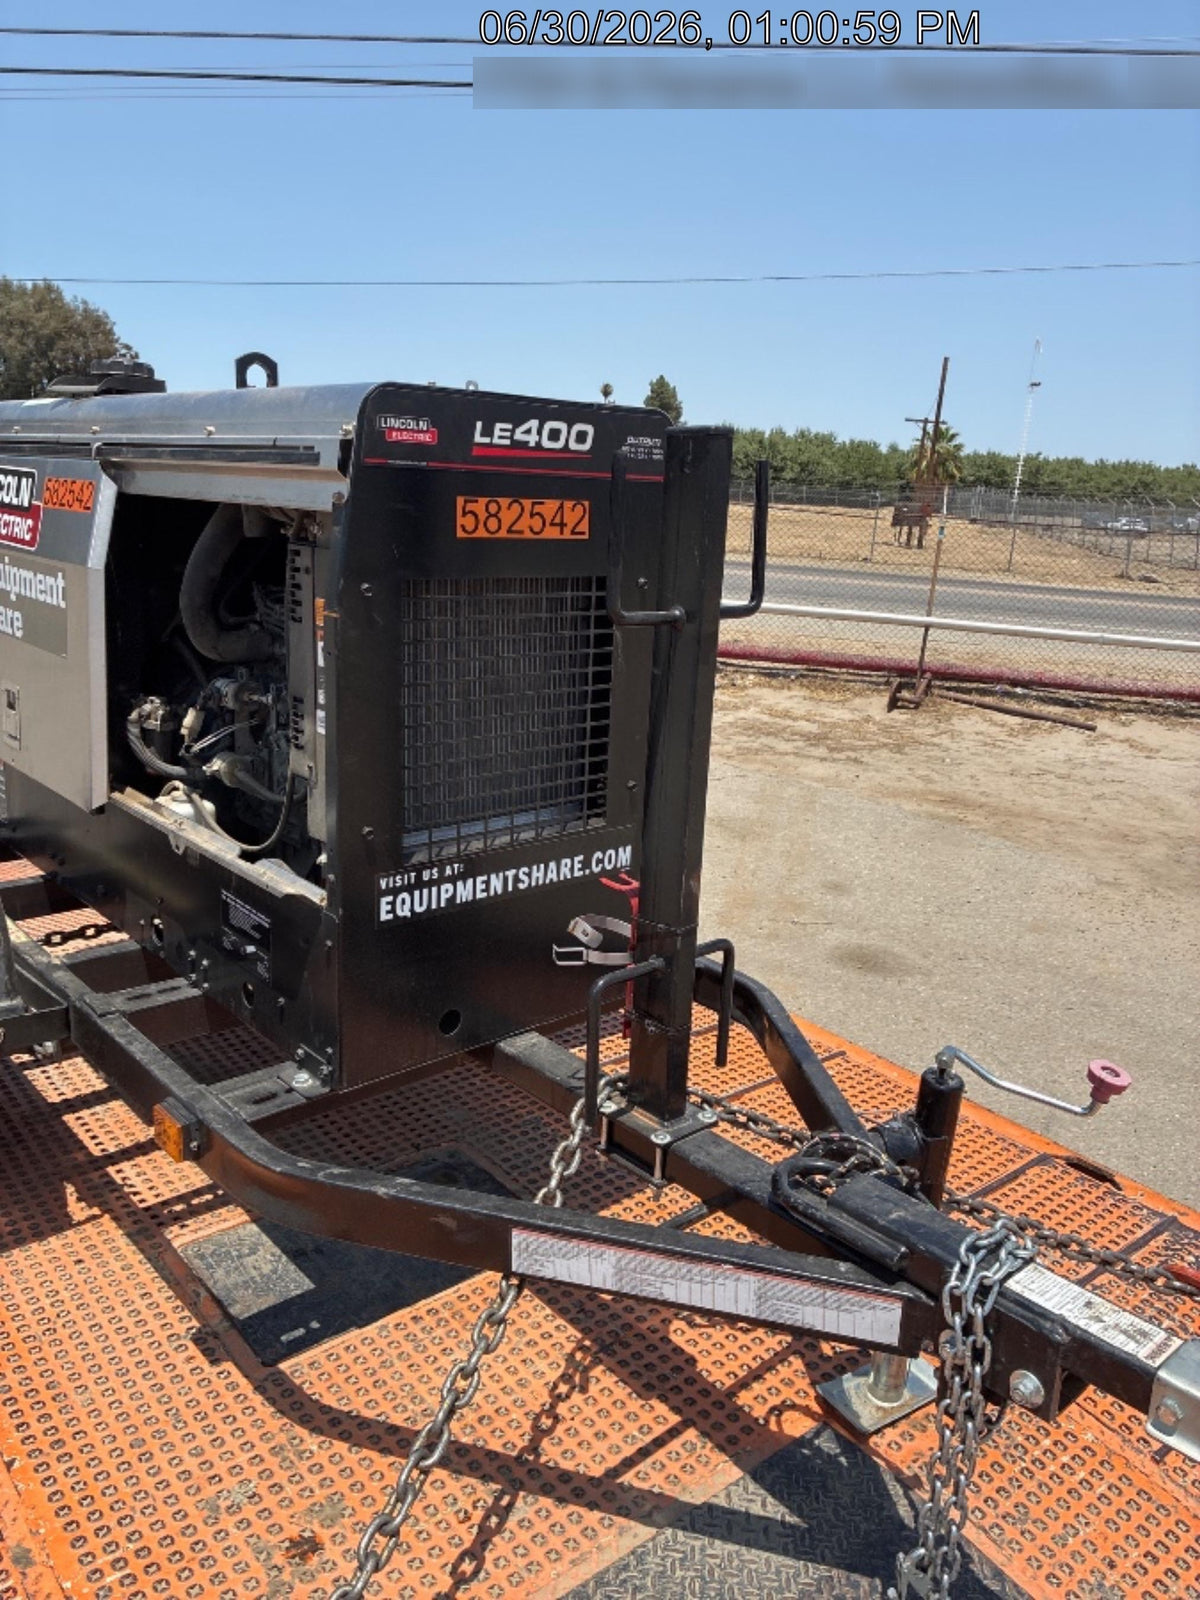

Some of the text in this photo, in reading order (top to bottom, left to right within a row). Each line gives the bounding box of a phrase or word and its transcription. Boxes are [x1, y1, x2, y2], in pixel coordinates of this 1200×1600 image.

[380, 416, 428, 431] LINCOLN
[391, 431, 433, 442] ELECTRIC
[473, 419, 595, 451] LE400
[44, 477, 95, 511] 582542
[0, 512, 33, 541] CTRIC
[459, 498, 588, 536] 582542
[379, 845, 633, 922] EQUIPMENTSHARE.COM
[380, 863, 464, 890] VISIT US AT:
